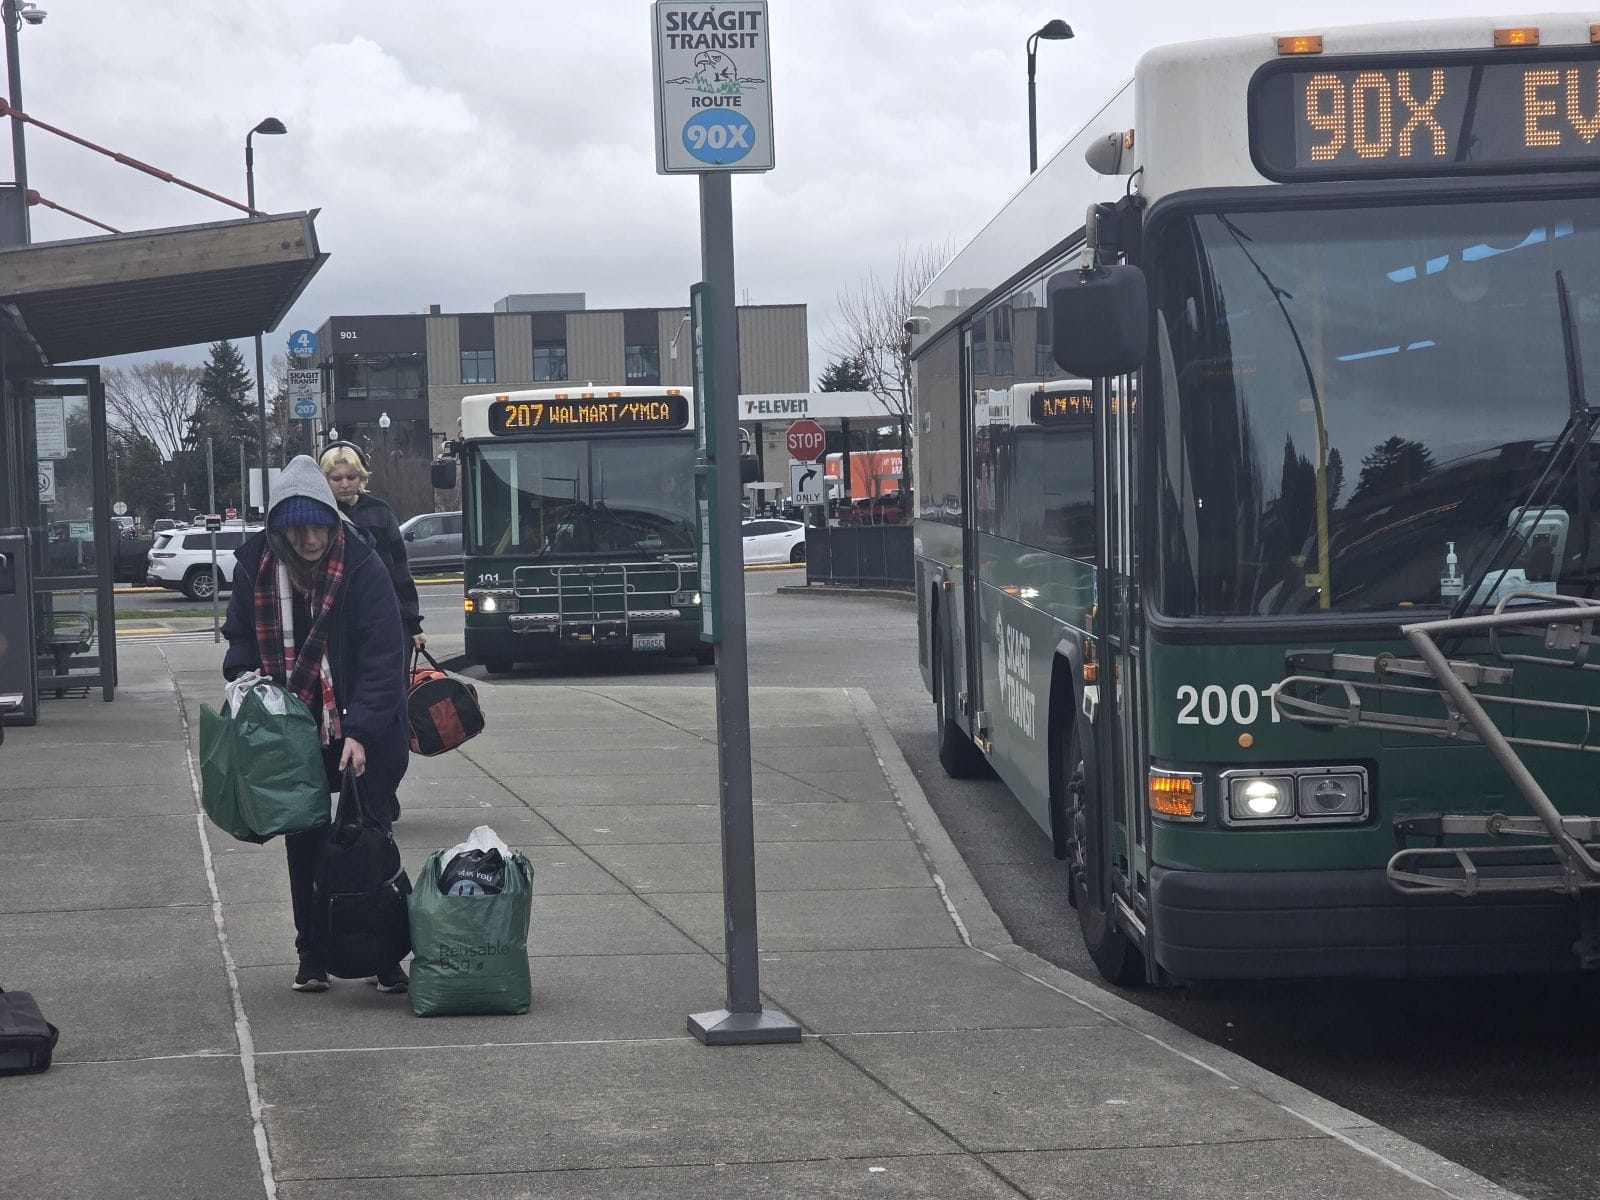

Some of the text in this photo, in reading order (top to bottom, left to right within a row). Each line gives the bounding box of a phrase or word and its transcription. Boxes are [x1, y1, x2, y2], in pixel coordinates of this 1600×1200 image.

[665, 10, 762, 32] SKAGIT
[666, 32, 759, 50] TRANSIT
[691, 95, 742, 108] ROUTE
[1305, 66, 1447, 161] 90X
[687, 124, 750, 149] 90X
[297, 333, 310, 347] 4
[340, 331, 358, 339] 901
[296, 405, 316, 414] 207
[505, 402, 670, 428] 207 WALMART/YMCA
[788, 432, 823, 449] STOP
[796, 493, 820, 503] ONLY
[1006, 623, 1031, 684] SKAGIT
[1007, 673, 1036, 741] TRANSIT
[1176, 683, 1281, 726] 2001
[476, 870, 493, 882] YOU
[440, 940, 510, 957] Reusable
[440, 958, 471, 975] Bag
